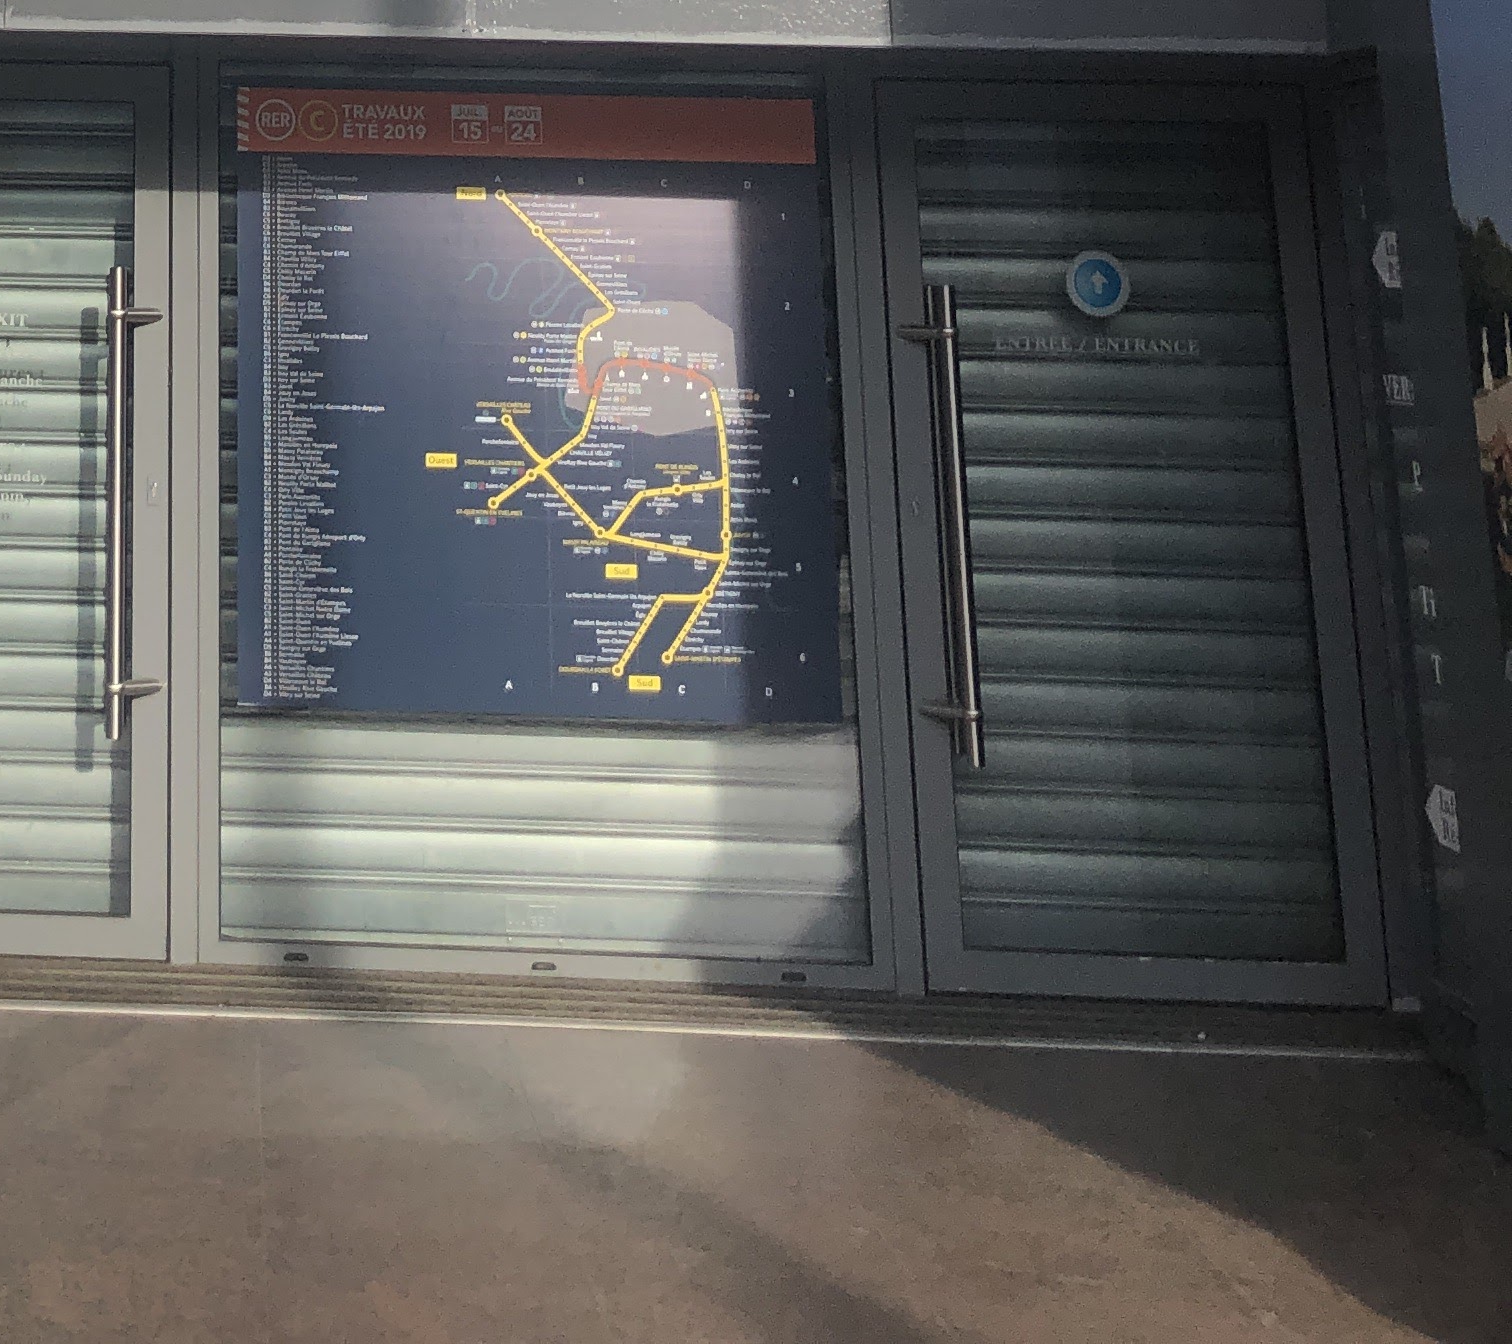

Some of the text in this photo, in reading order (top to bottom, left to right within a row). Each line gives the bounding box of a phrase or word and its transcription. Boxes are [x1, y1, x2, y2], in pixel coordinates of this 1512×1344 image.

[261, 110, 326, 131] RER C
[341, 104, 426, 121] TRAVAUX
[343, 120, 427, 141] ÉTÉ 2019
[458, 122, 483, 141] 15
[510, 122, 537, 142] 24
[1094, 337, 1201, 355] ENTRANCE
[504, 679, 514, 690] A
[591, 682, 599, 693] B
[678, 684, 686, 695] C
[765, 687, 773, 697] D
